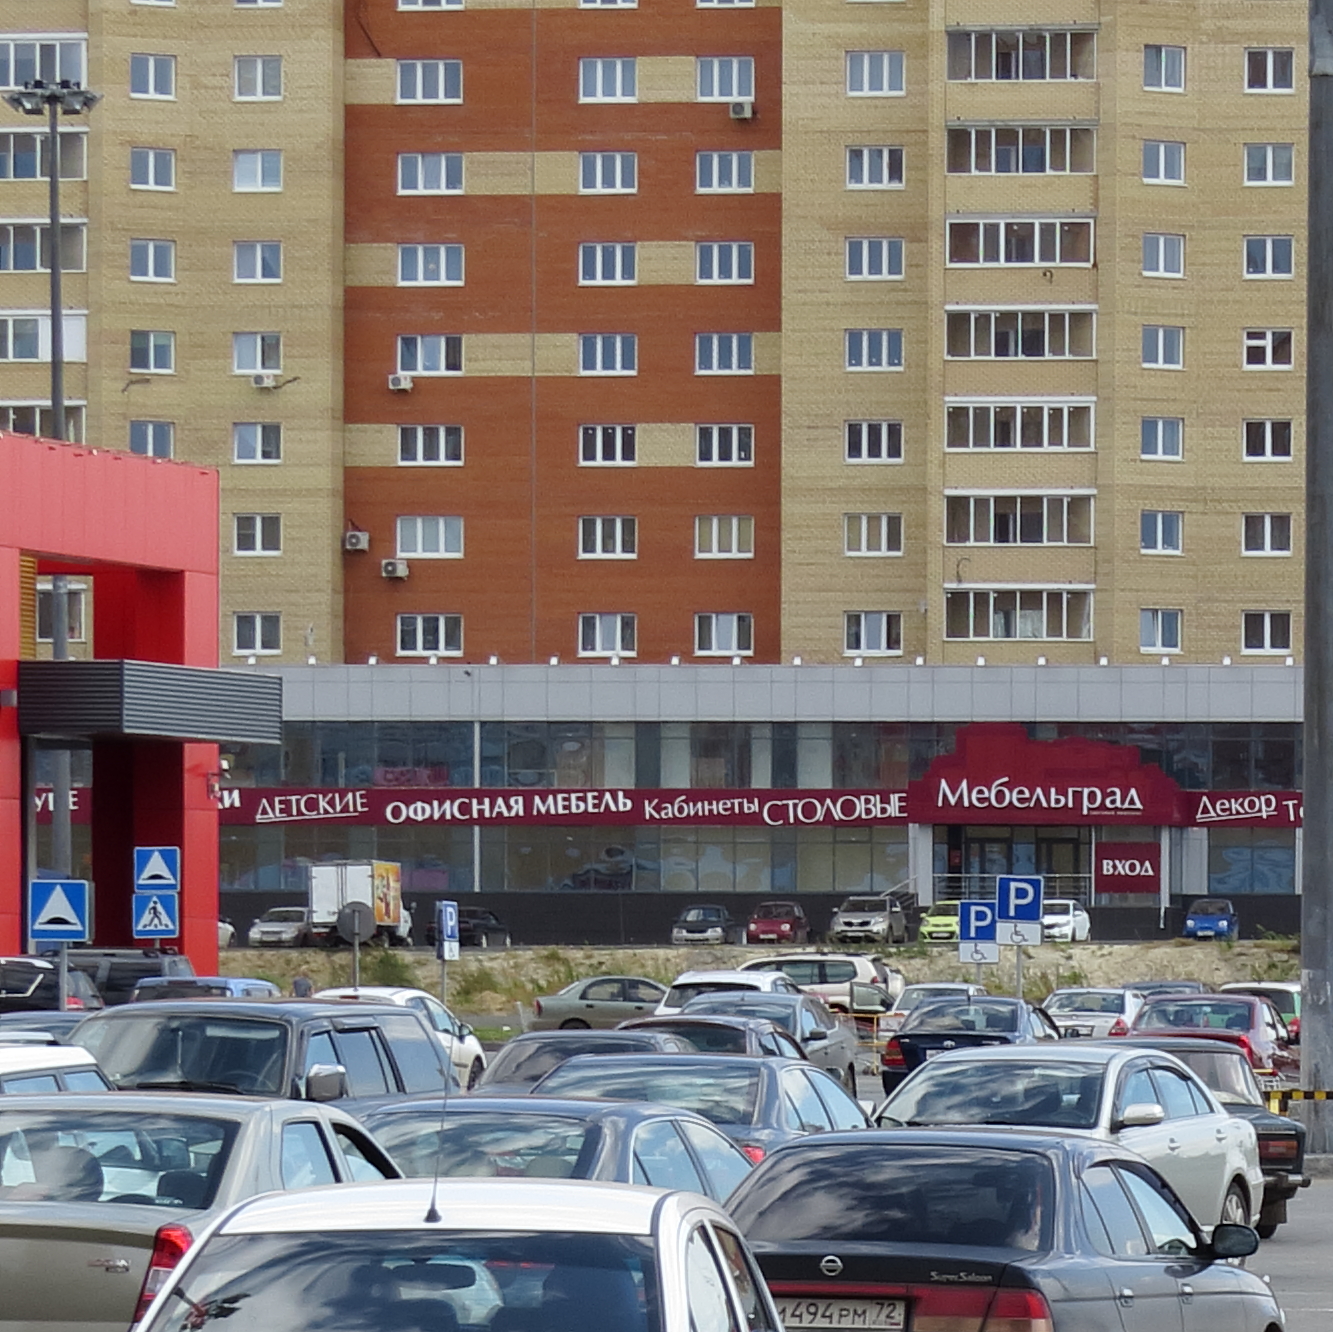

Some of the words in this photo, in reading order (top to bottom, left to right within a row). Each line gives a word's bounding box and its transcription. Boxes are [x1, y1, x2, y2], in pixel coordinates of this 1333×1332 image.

[255, 790, 369, 822] ДЕТСКИЕ
[385, 796, 525, 824] ОФИСНАЯ
[532, 790, 633, 816] МЕБЕЛЬ
[644, 795, 759, 820] Кабинеты
[762, 793, 908, 826] СТОЛОВЫЕ
[937, 776, 1143, 815] Мебельград
[1196, 794, 1278, 822] Декор
[1102, 859, 1154, 876] ВХОД
[1009, 881, 1034, 917] P
[969, 905, 993, 938] P
[875, 1302, 897, 1320] 72
